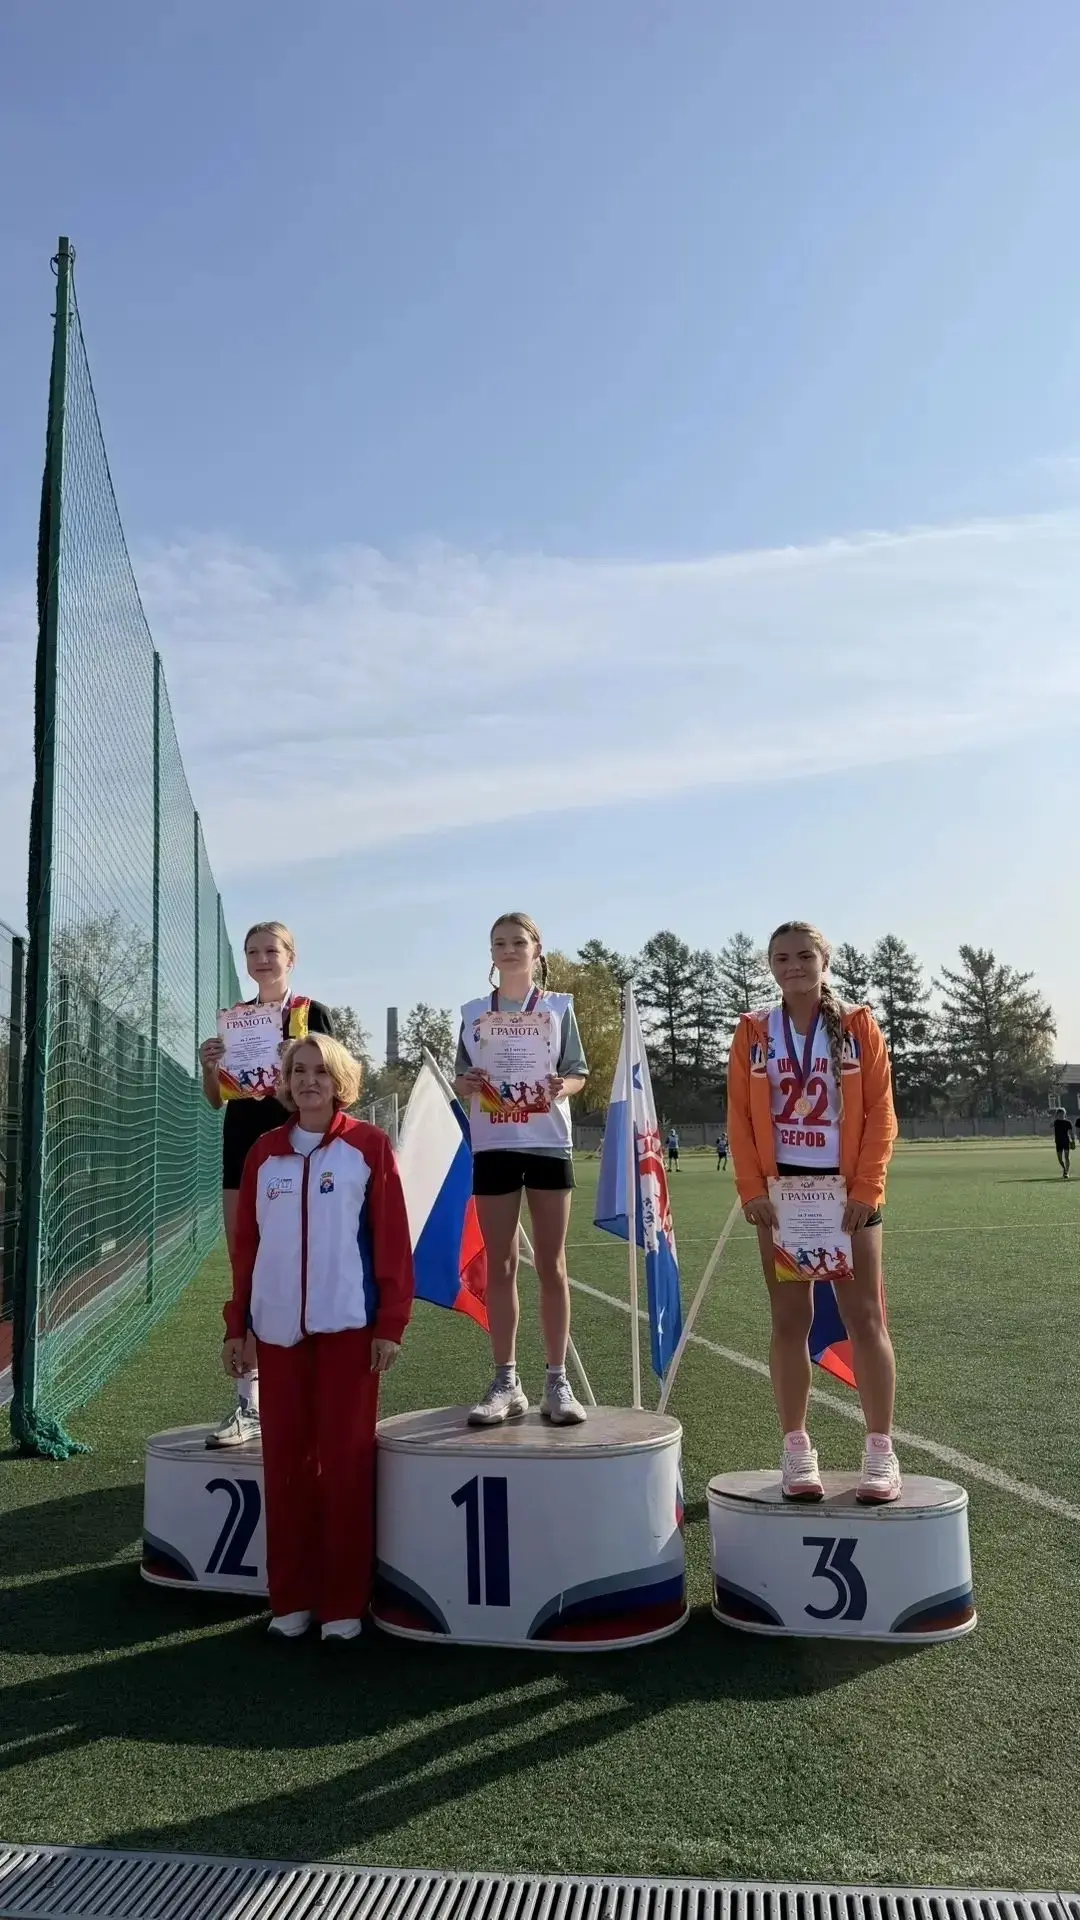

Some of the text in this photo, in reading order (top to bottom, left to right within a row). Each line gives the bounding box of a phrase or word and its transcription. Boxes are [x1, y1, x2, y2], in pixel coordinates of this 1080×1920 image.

[226, 1017, 272, 1029] ГРАМОТА
[491, 1027, 540, 1036] ГРАМОТА
[777, 1057, 828, 1073] ШЛА
[775, 1077, 832, 1126] 22
[490, 1111, 529, 1124] СЕРОВ
[780, 1129, 826, 1148] СЕРОВ
[781, 1192, 835, 1201] ГРАМОТА
[204, 1478, 261, 1577] 2
[450, 1475, 511, 1607] 1
[803, 1536, 867, 1621] 3
